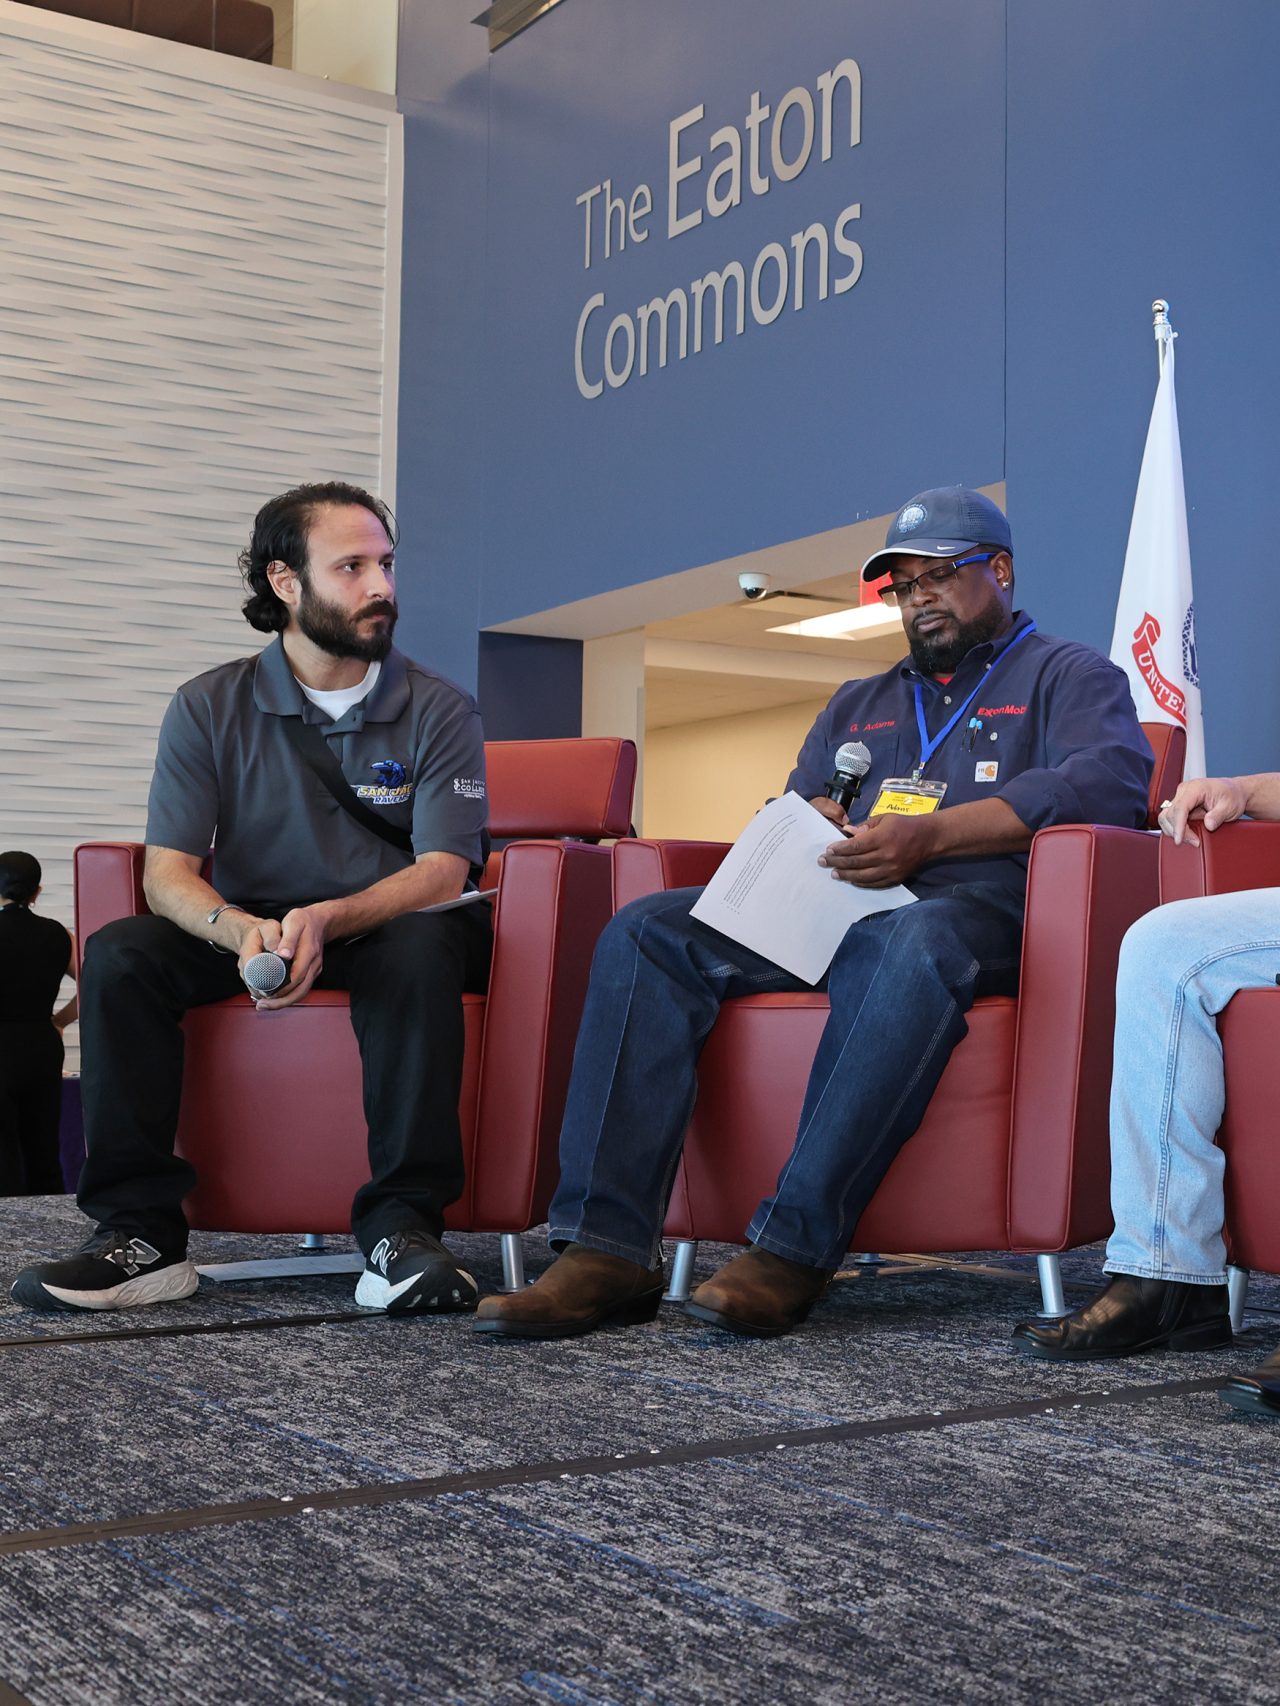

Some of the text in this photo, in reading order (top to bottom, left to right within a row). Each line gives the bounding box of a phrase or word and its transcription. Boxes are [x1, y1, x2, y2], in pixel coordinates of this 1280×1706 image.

[576, 58, 863, 270] The Eaton
[573, 202, 865, 400] Commons
[359, 786, 388, 796] SAN
